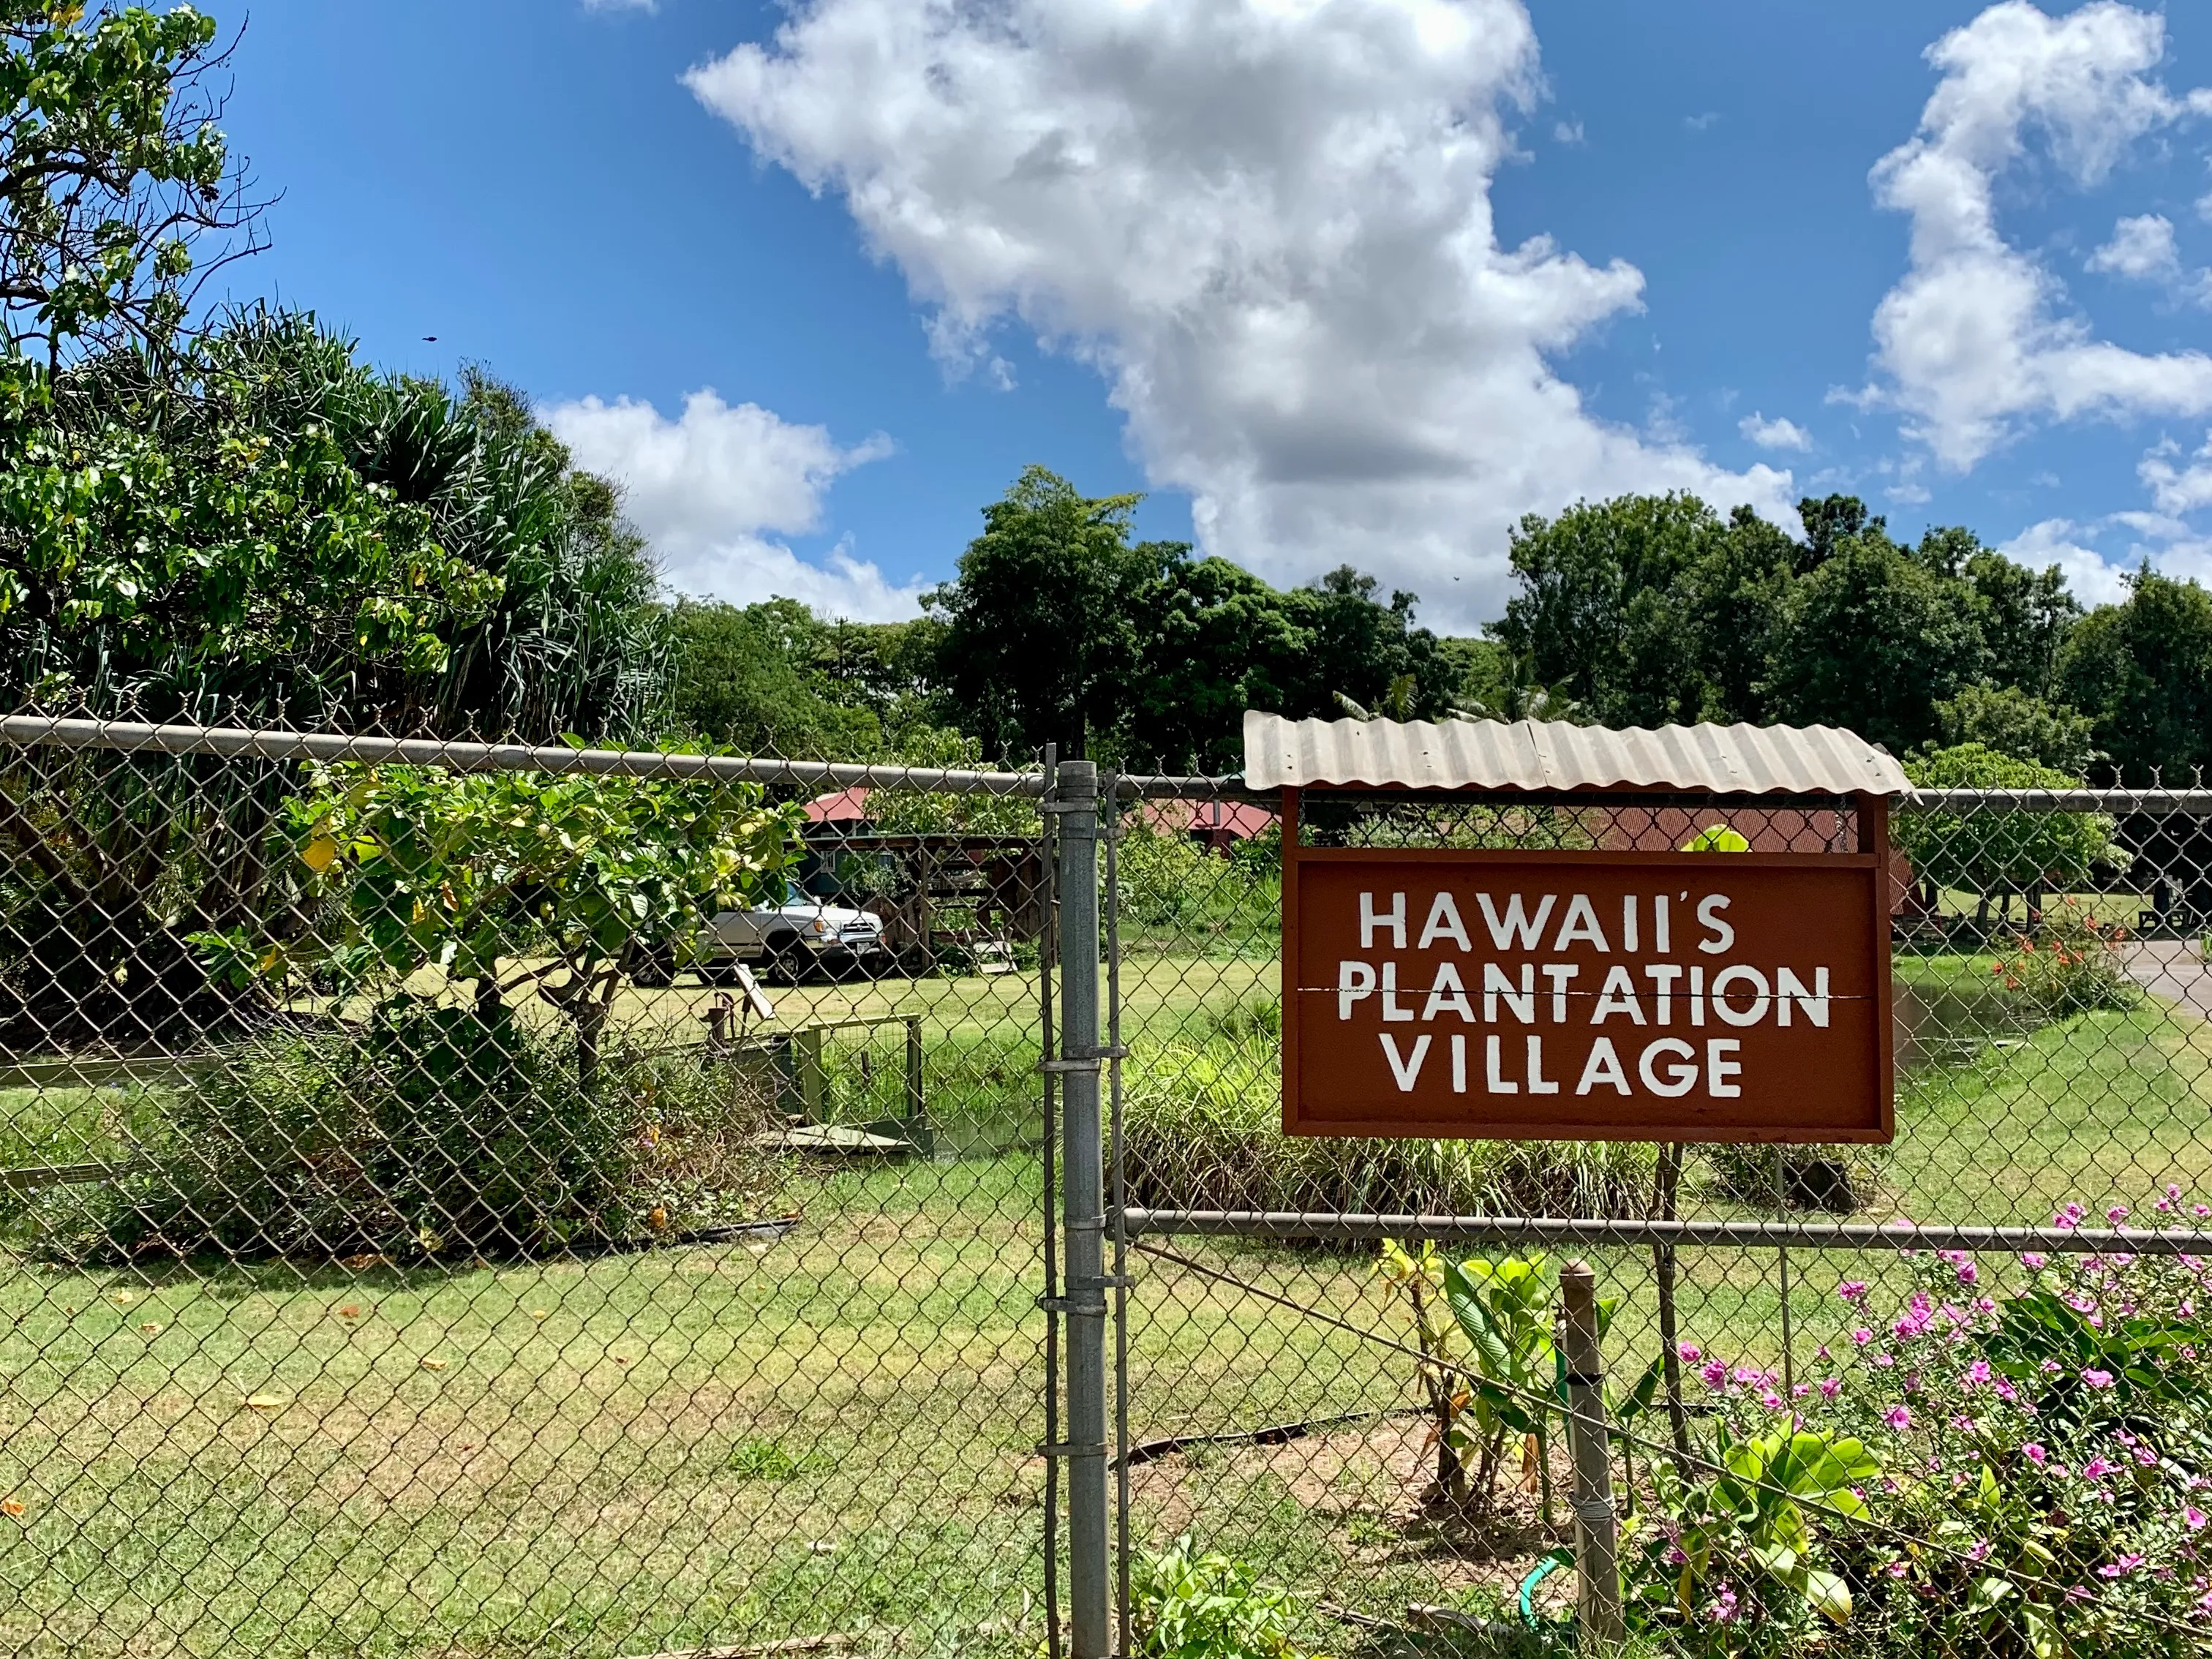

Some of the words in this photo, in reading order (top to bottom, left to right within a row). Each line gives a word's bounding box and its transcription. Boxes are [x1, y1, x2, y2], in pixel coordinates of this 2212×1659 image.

[1360, 890, 1735, 955] HAWAII'S
[1338, 960, 1830, 1028] PLANTATION
[1378, 1033, 1742, 1098] VILLAGE
